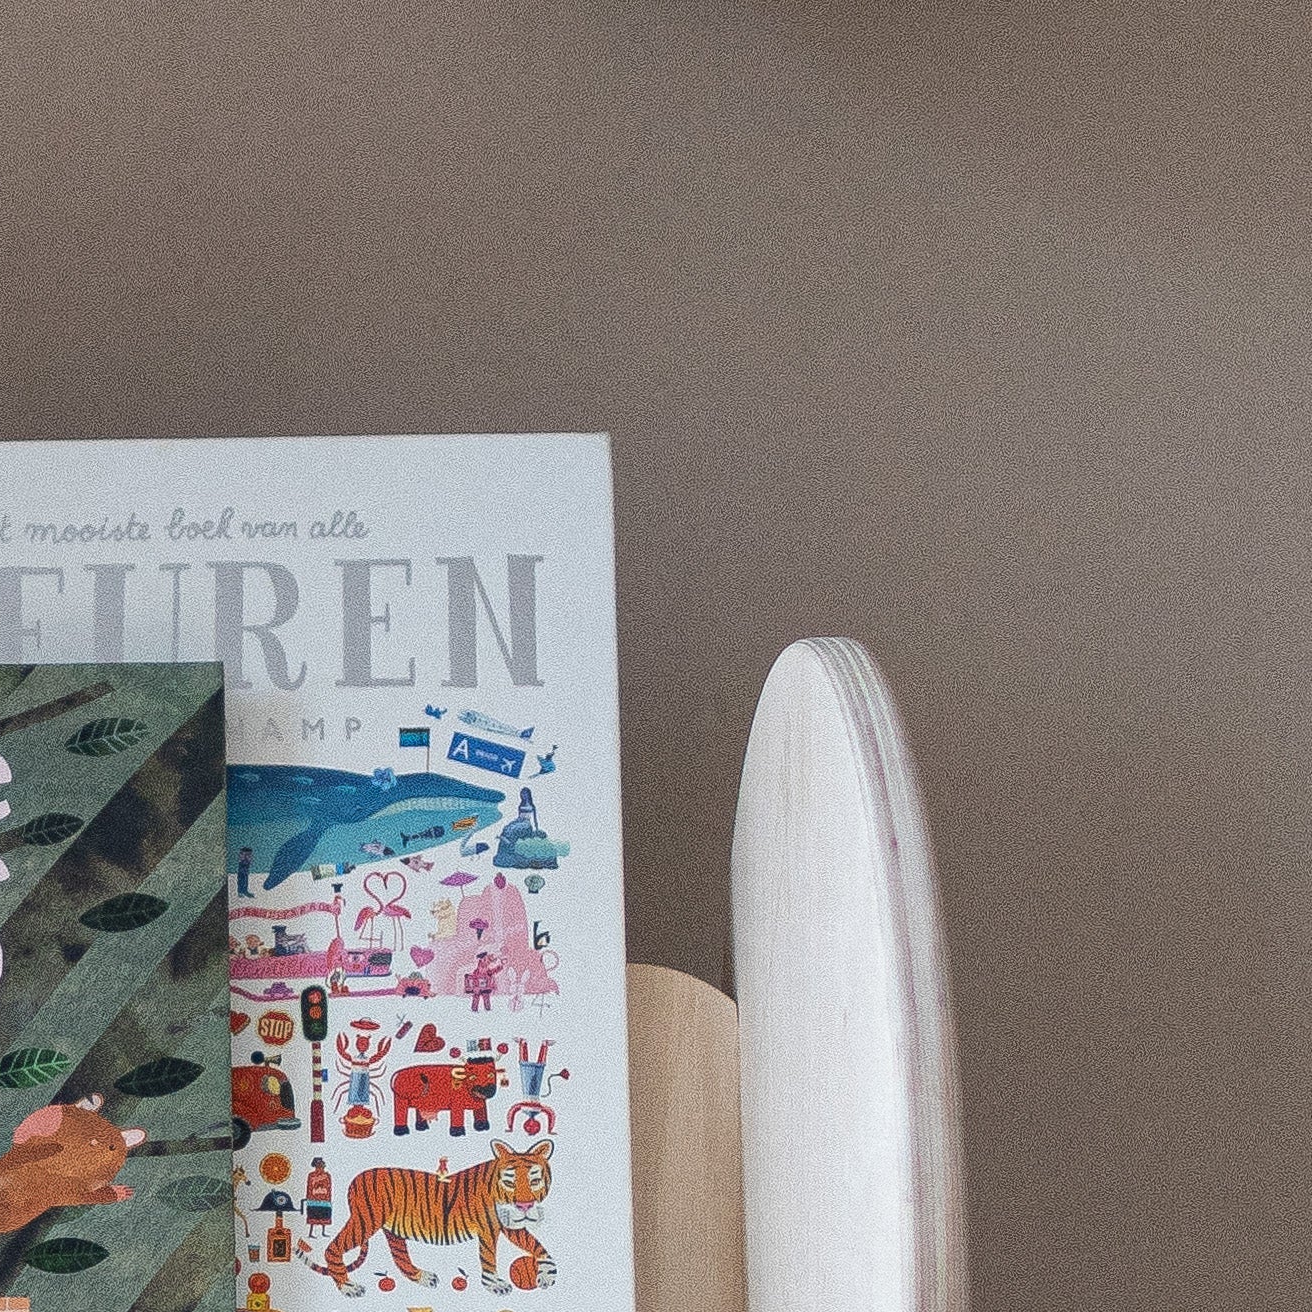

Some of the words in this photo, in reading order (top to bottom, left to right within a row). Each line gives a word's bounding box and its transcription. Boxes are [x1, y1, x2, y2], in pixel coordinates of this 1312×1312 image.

[24, 512, 151, 545] mooiste
[164, 506, 233, 541] boek
[241, 516, 298, 540] van
[309, 508, 372, 540] alle
[259, 1017, 293, 1040] STOP
